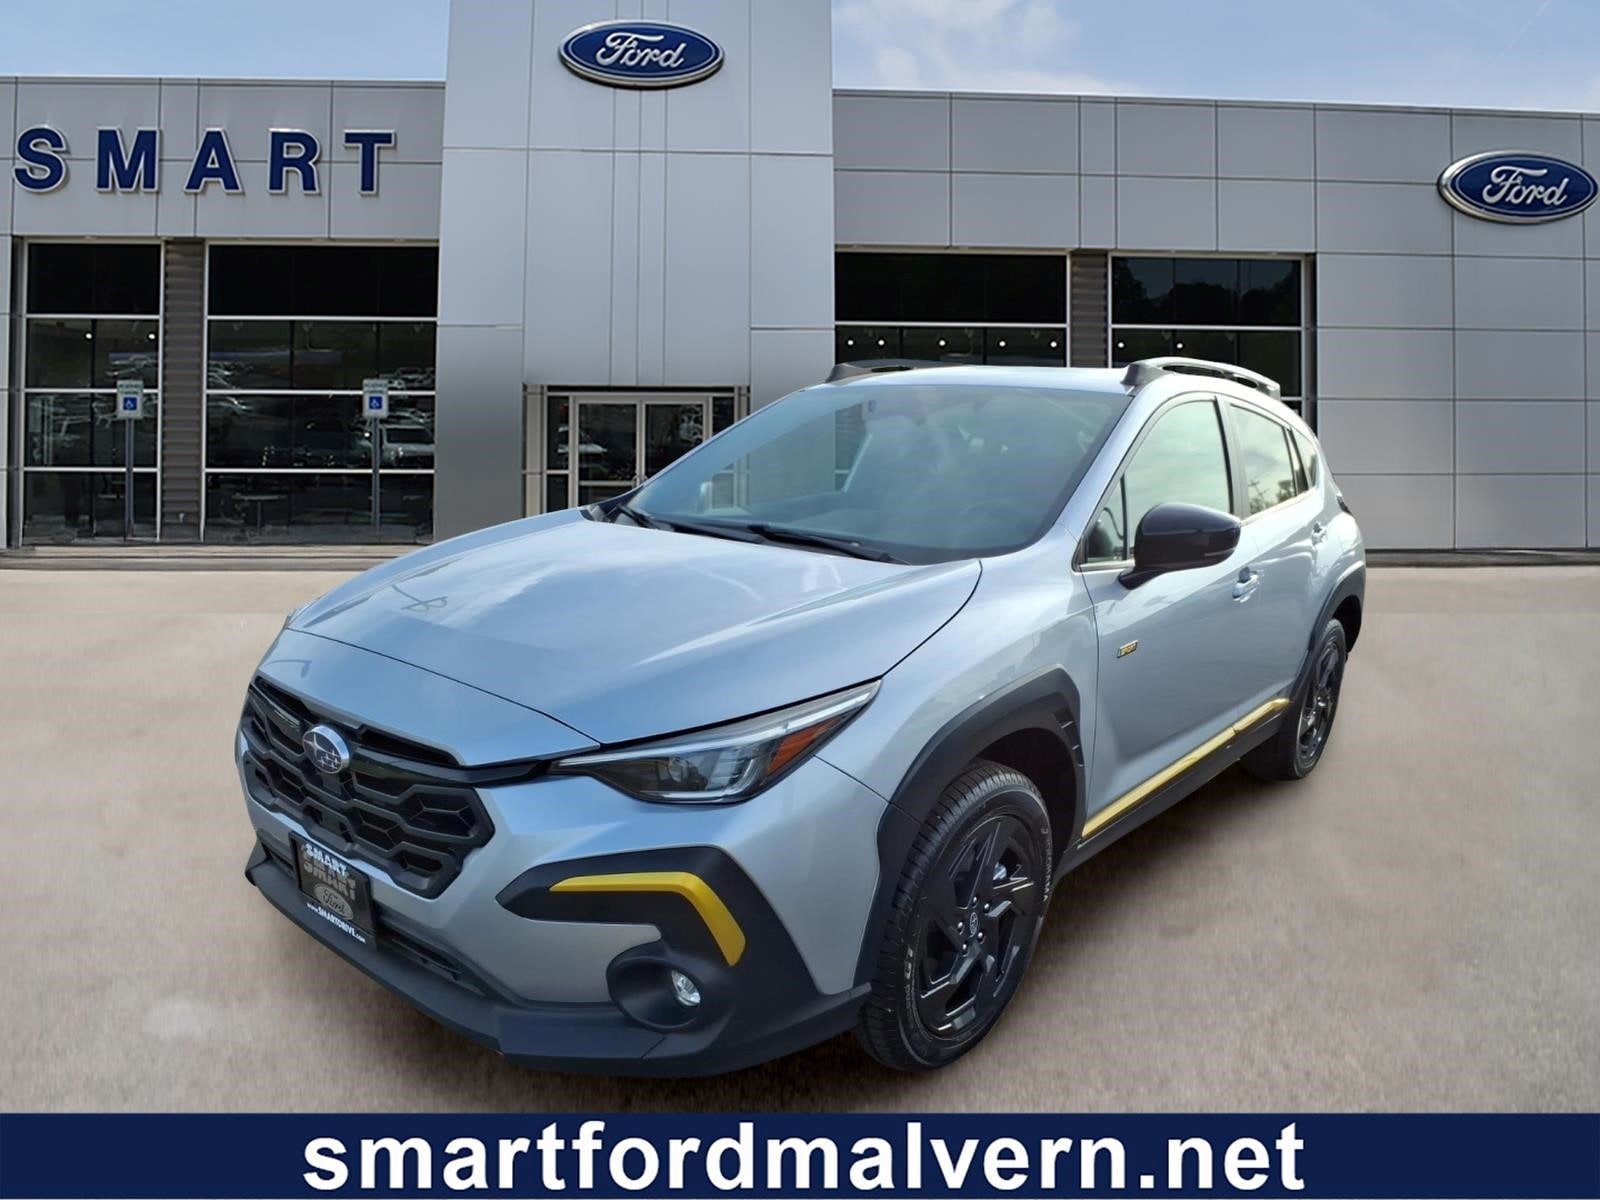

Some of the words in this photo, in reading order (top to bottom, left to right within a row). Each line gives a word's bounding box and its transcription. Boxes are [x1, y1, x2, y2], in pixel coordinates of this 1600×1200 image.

[595, 32, 687, 68] Ford
[13, 126, 396, 195] SMART
[1482, 165, 1570, 206] Ford
[304, 842, 348, 876] SMART
[322, 888, 346, 913] Ford
